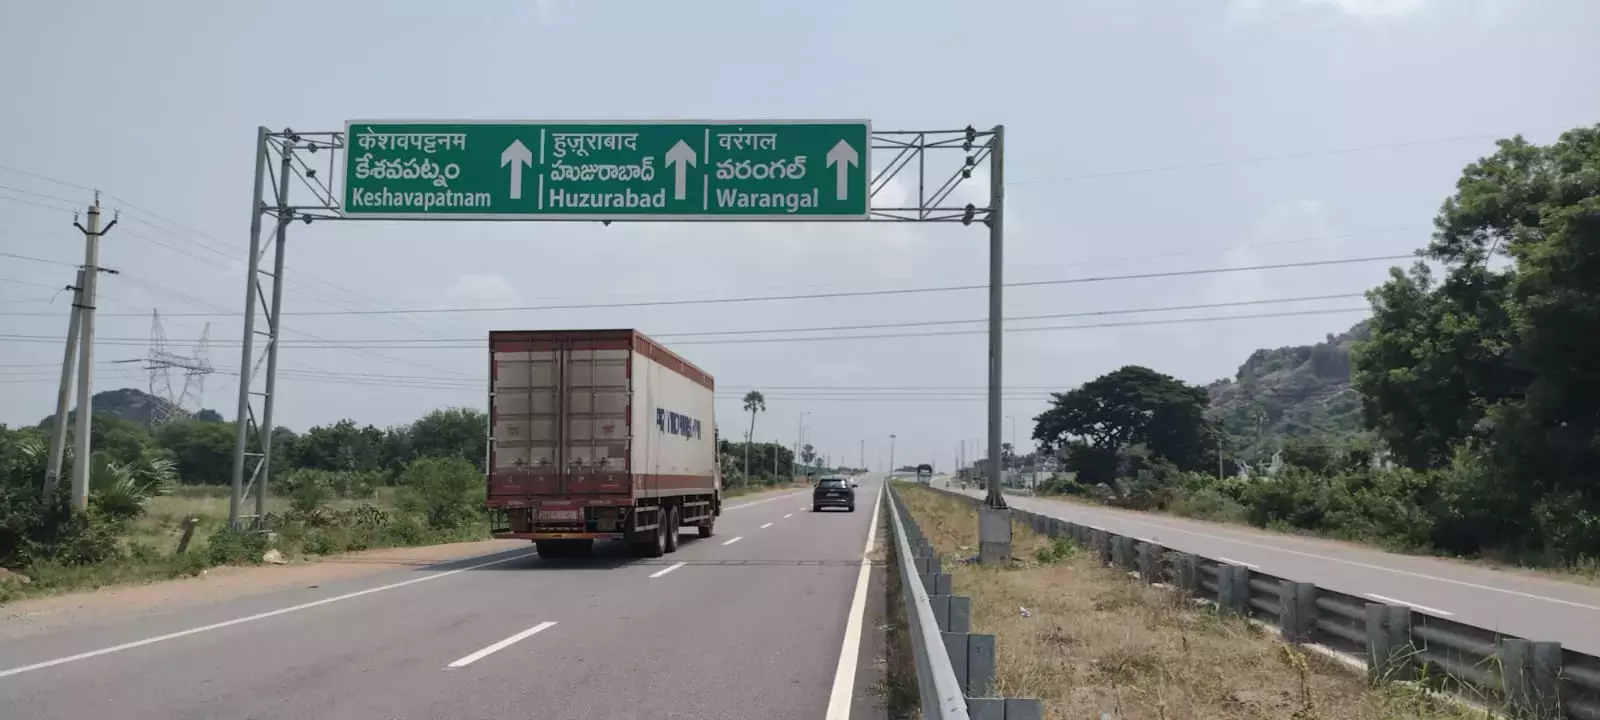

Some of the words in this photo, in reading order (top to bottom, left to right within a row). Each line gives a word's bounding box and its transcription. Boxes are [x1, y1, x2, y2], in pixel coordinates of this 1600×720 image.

[717, 128, 778, 151] वरंगल
[356, 153, 461, 187] కేశవపట్నం
[717, 156, 807, 180] వరంగల్
[352, 187, 491, 211] Keshavapatnam
[550, 188, 666, 208] Huzurabad
[716, 188, 819, 212] Warangal
